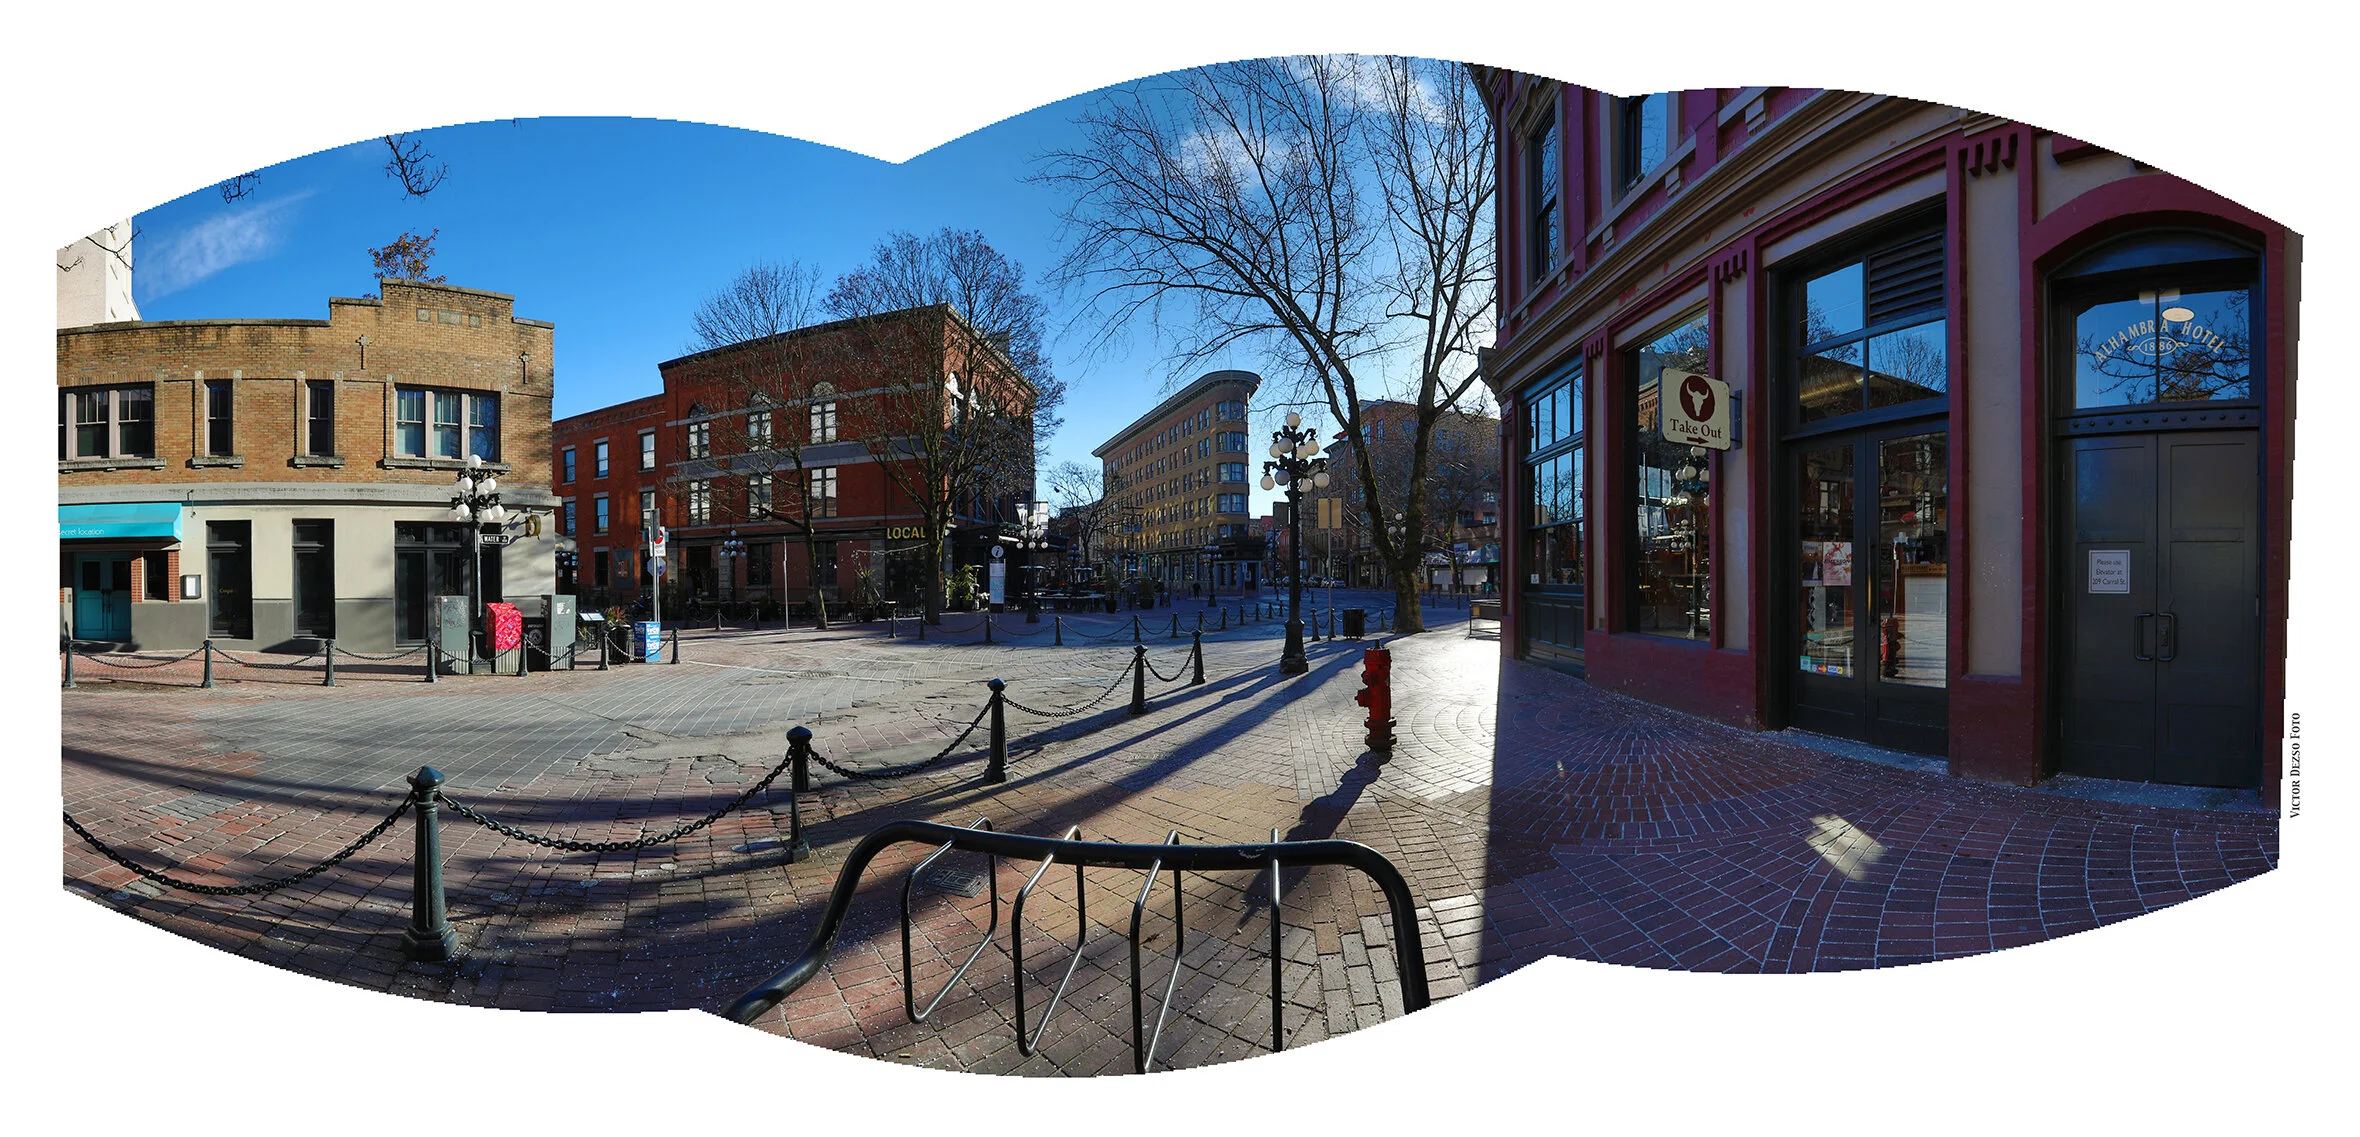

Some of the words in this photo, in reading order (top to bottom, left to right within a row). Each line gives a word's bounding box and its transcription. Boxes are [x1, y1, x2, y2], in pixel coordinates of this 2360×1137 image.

[2095, 319, 2169, 362] ALHAMBRA
[2181, 321, 2225, 354] HOTEL
[2144, 341, 2173, 352] 1886
[1669, 418, 1698, 434] Take
[1701, 424, 1722, 439] Out
[78, 527, 105, 536] location
[886, 526, 926, 539] LOCAL
[484, 535, 499, 543] WATER
[2096, 558, 2112, 566] Please
